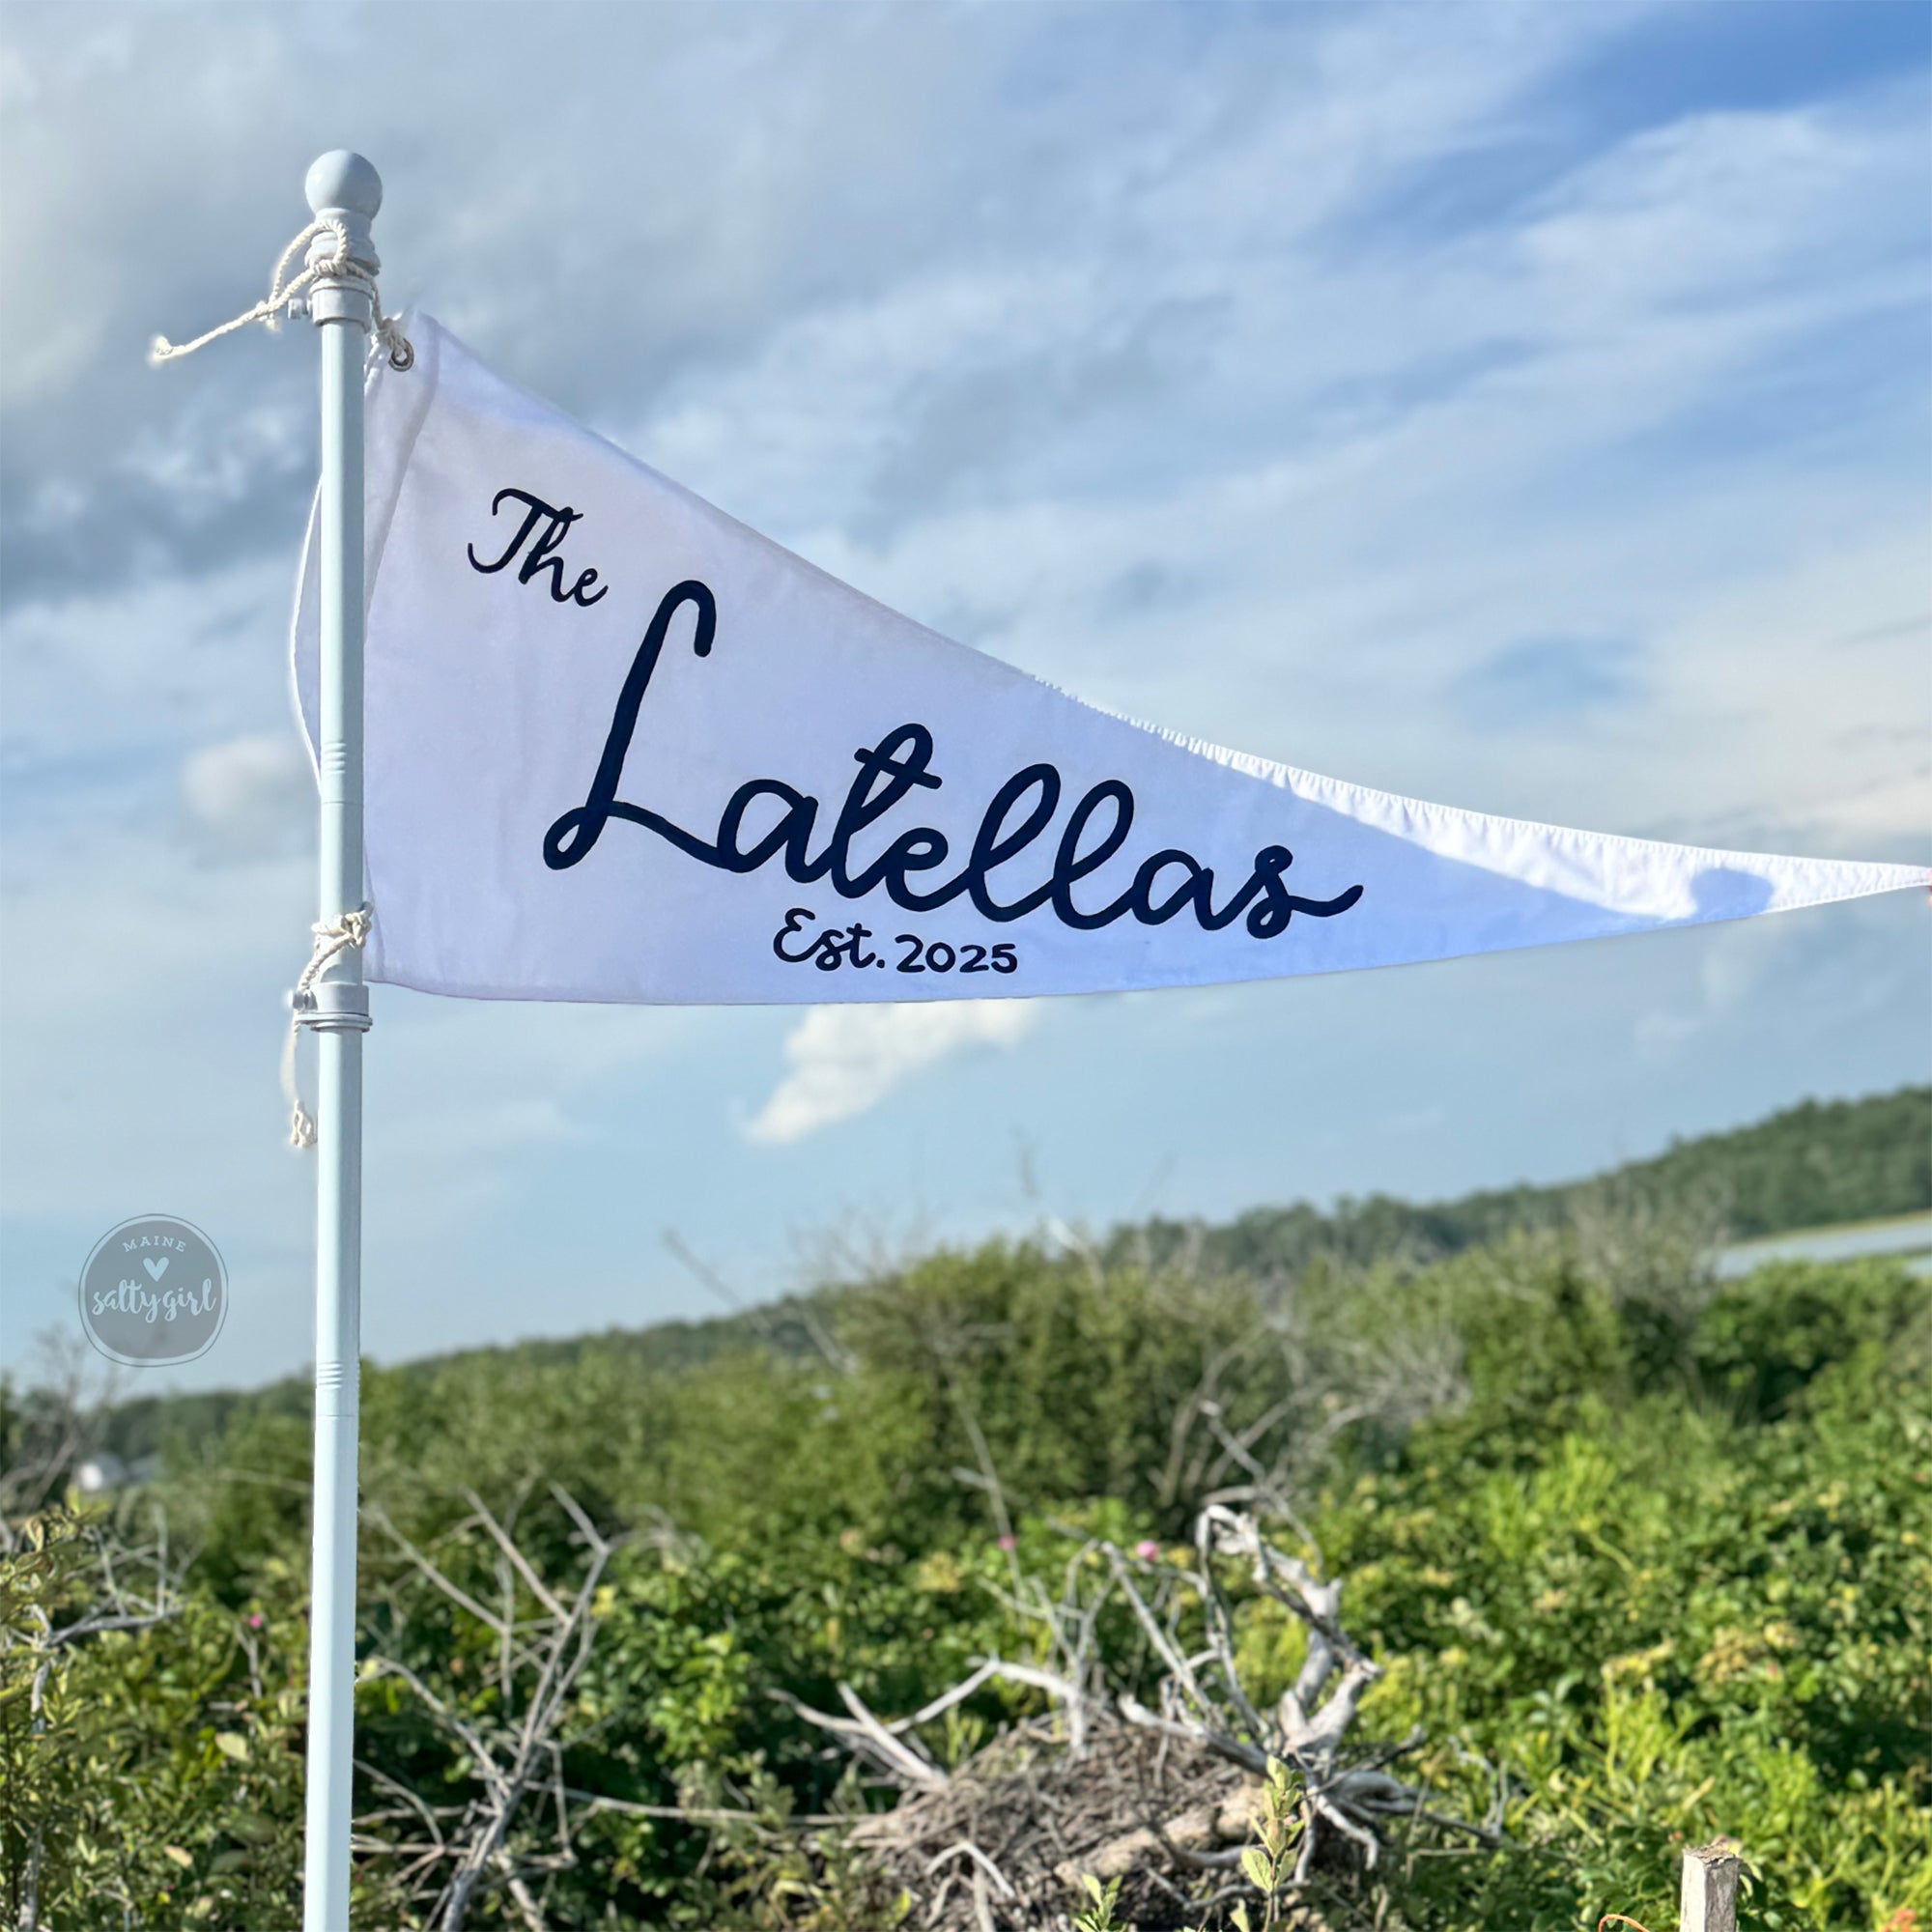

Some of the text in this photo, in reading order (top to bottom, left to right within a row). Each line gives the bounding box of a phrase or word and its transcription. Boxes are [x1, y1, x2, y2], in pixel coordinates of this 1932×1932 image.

[467, 488, 609, 608] The
[543, 580, 1364, 940] Latellas
[773, 907, 1018, 975] Est. 2025
